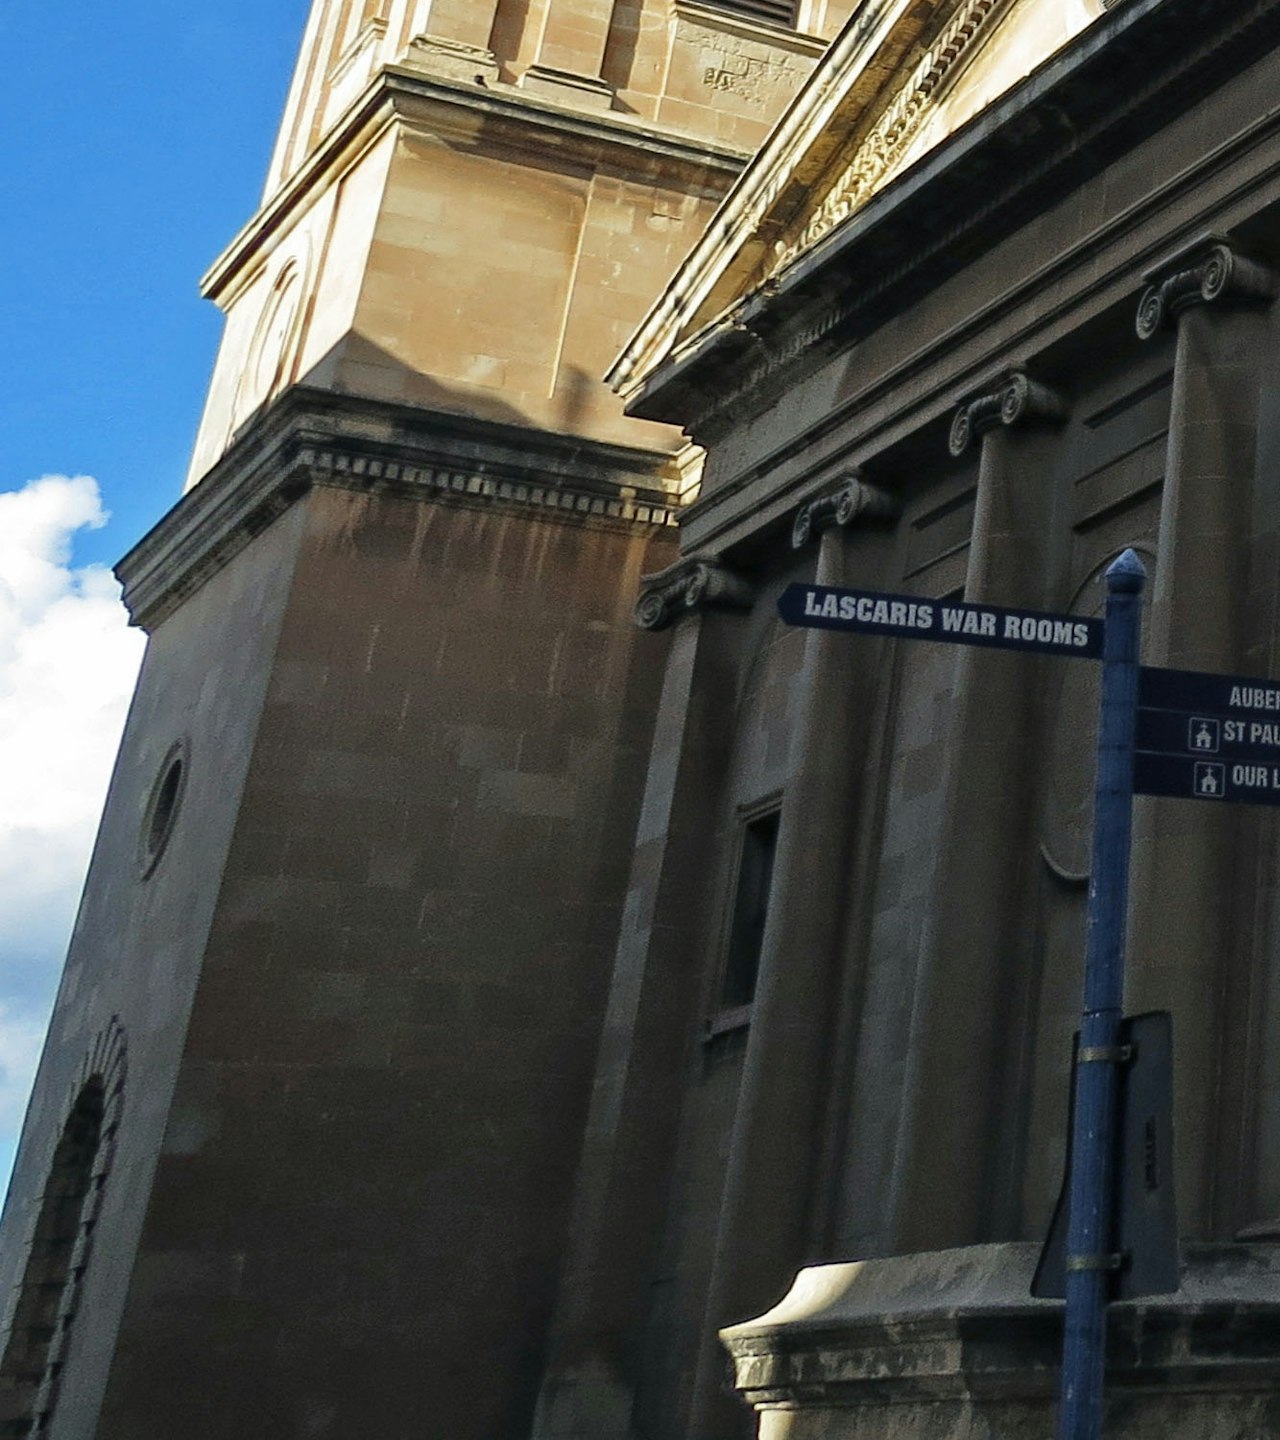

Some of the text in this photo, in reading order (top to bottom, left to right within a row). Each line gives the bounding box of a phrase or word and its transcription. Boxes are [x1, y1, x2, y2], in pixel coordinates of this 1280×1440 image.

[804, 591, 1089, 647] LASCARIS WAR ROOMS
[1223, 720, 1246, 742] ST
[1232, 764, 1268, 788] OUR
